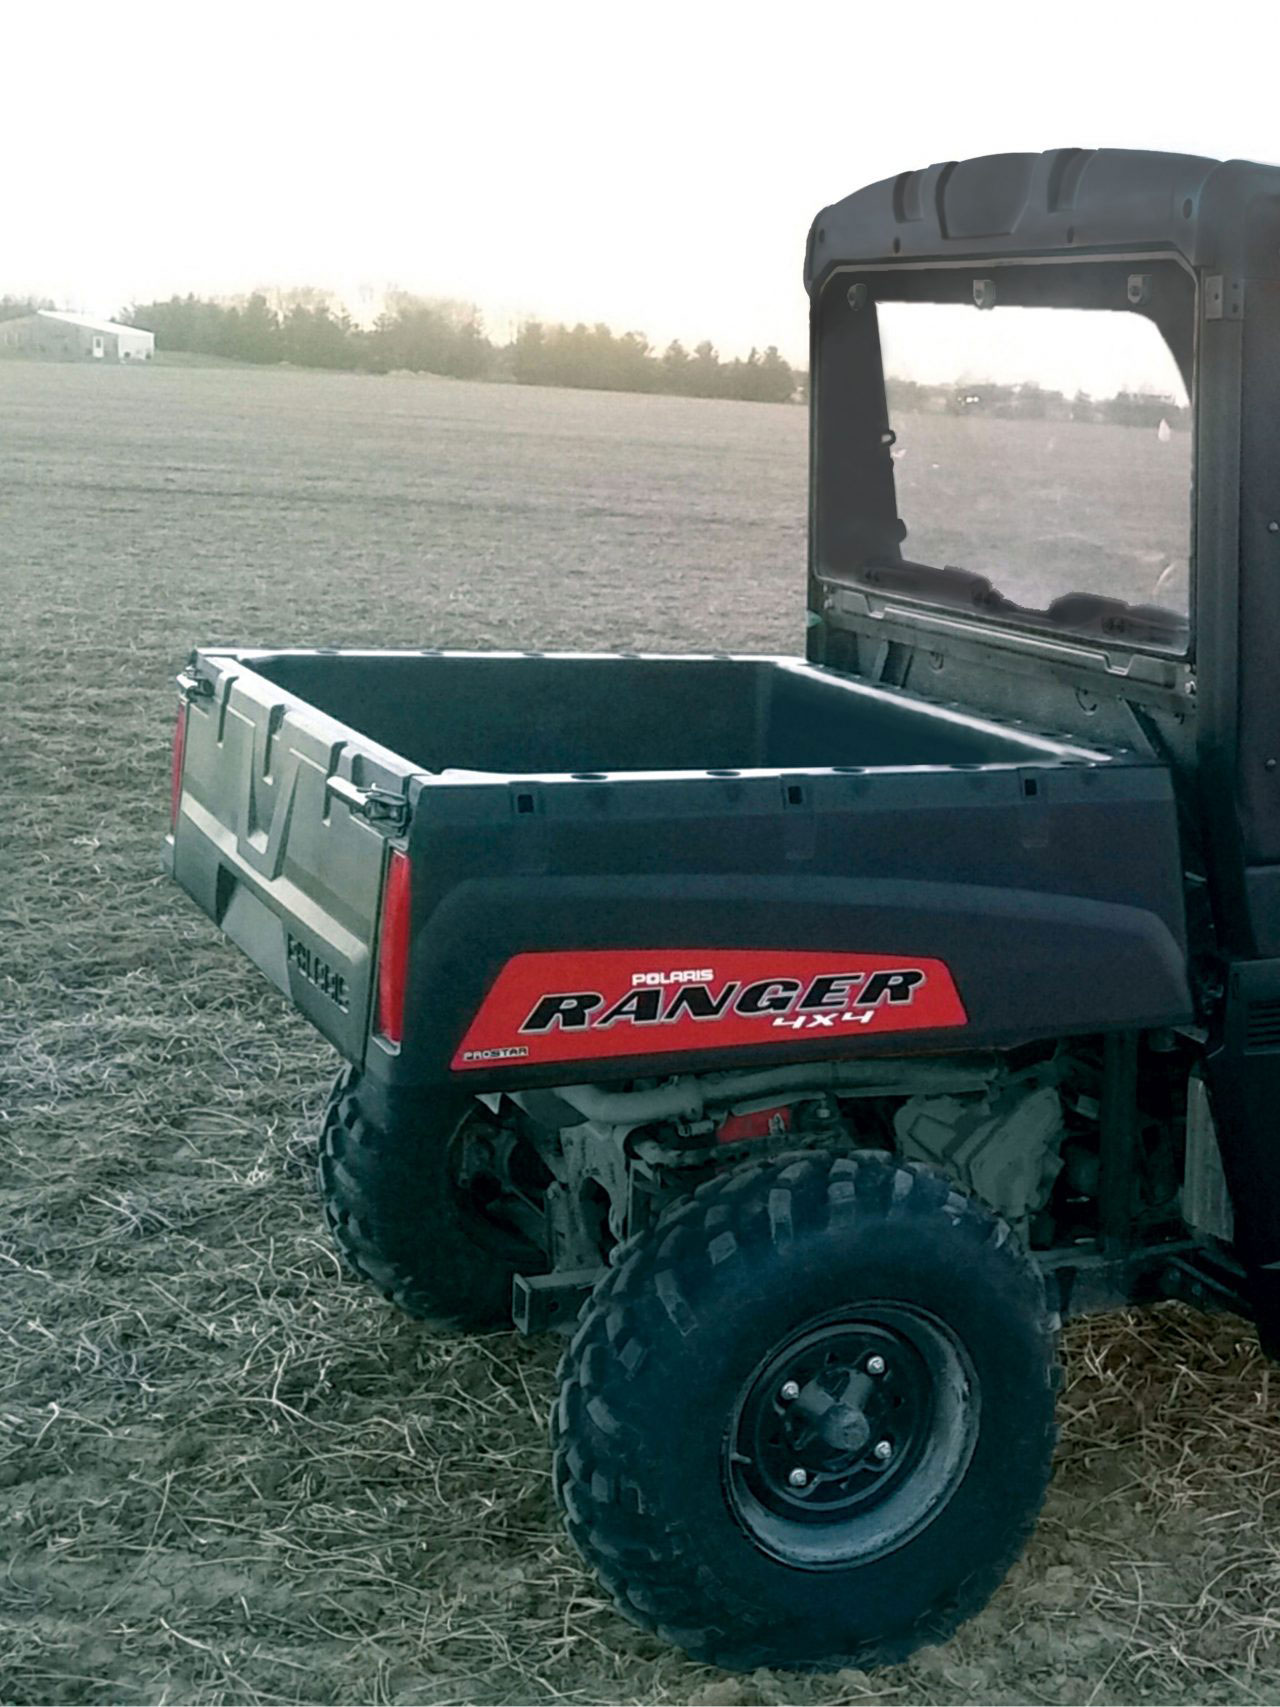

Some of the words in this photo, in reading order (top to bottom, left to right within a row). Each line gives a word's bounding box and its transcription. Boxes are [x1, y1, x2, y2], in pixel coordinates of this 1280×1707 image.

[632, 968, 714, 986] POLARIS
[518, 969, 926, 1035] RANGER
[464, 1046, 529, 1062] PROSTAR
